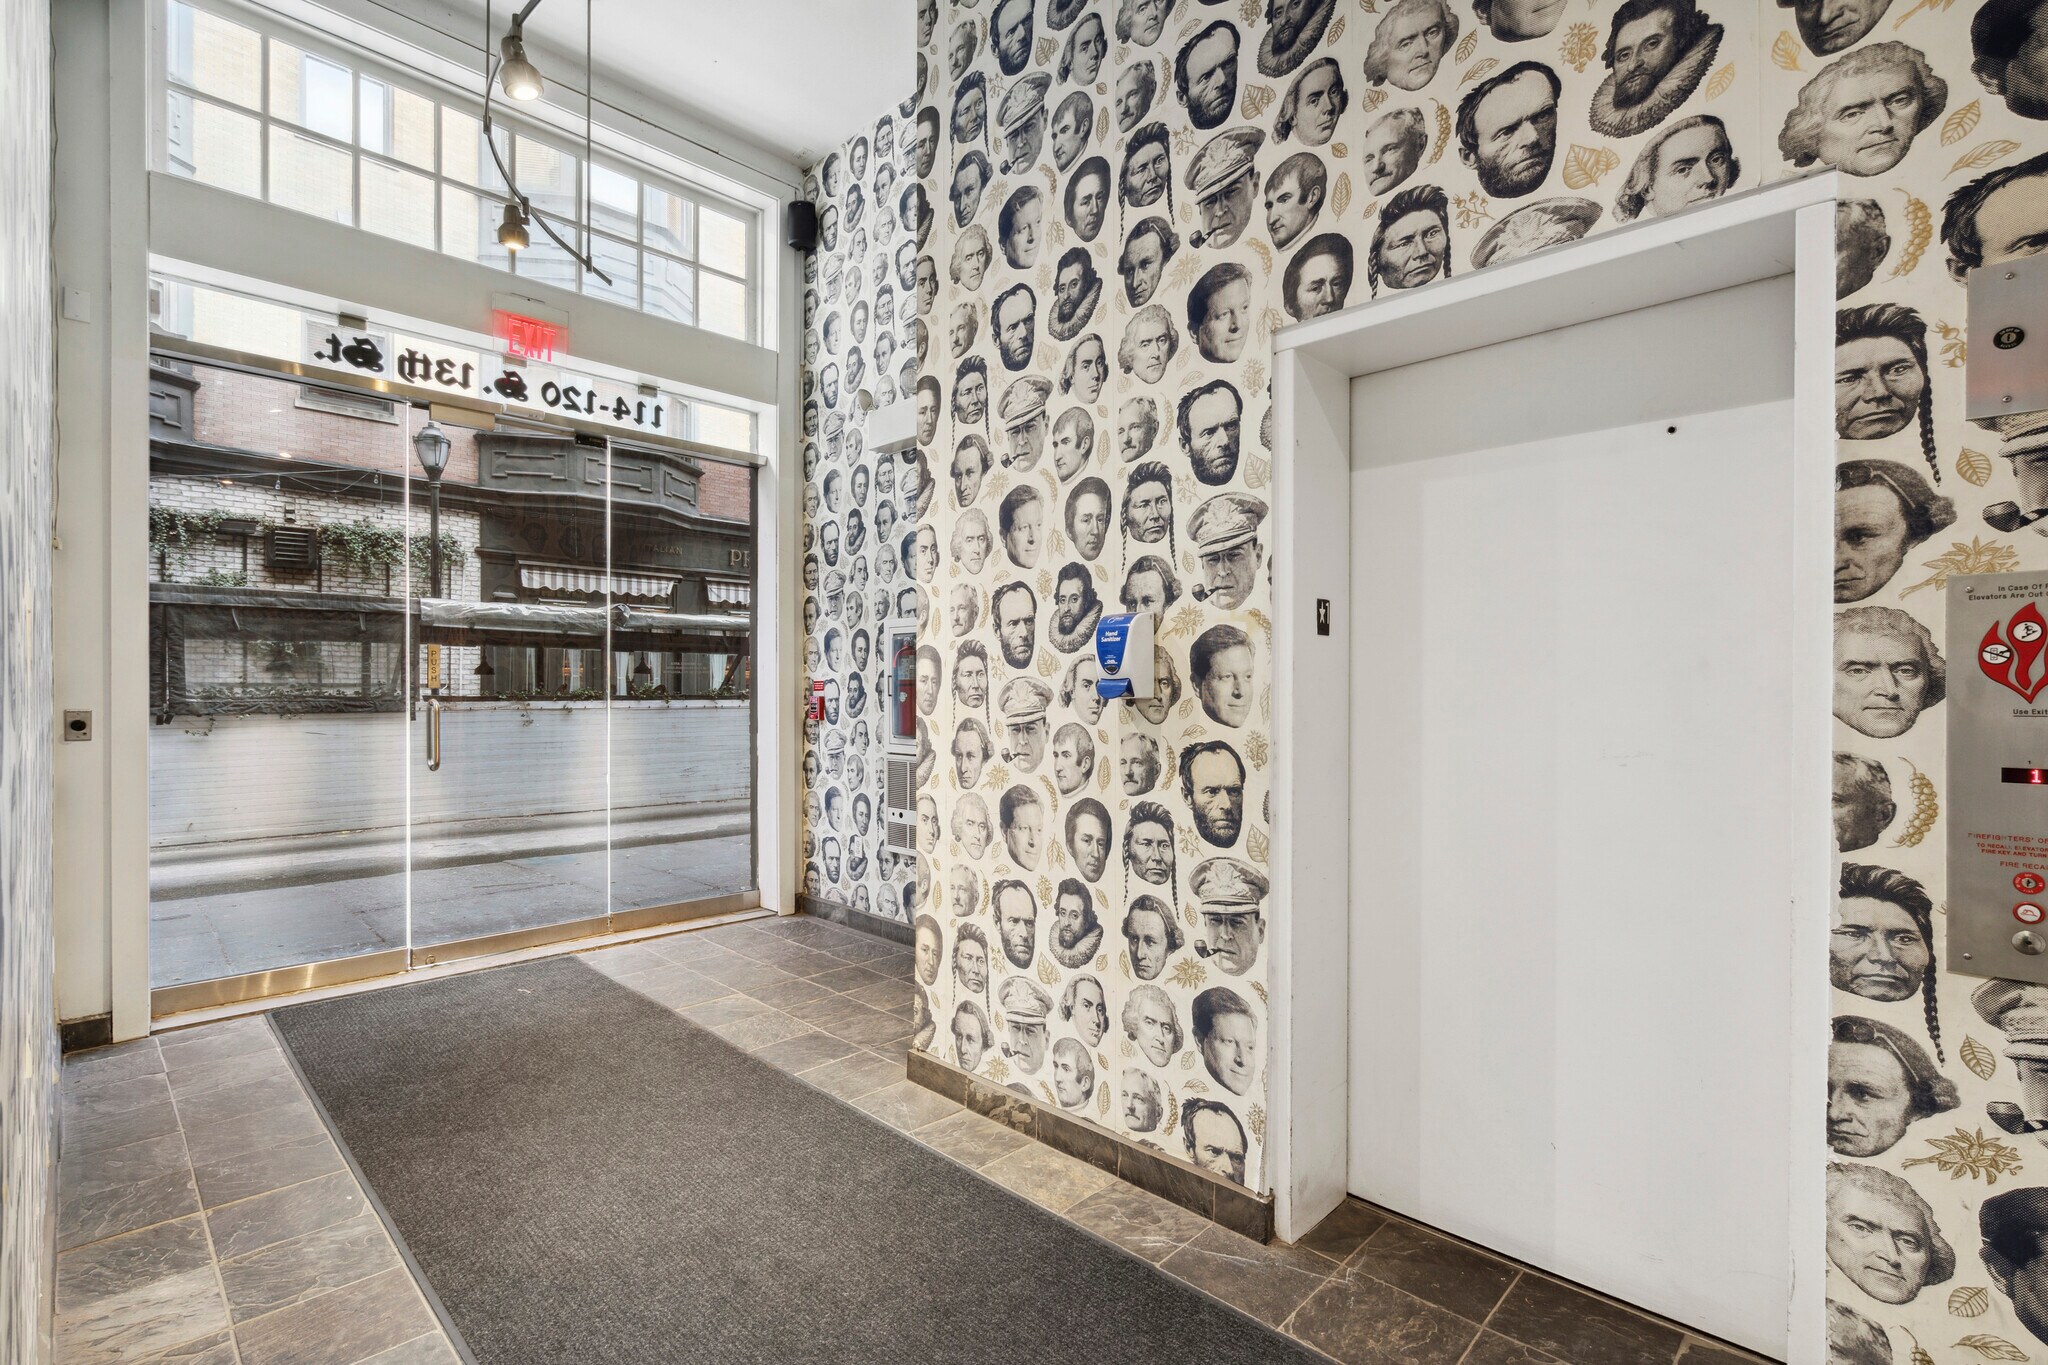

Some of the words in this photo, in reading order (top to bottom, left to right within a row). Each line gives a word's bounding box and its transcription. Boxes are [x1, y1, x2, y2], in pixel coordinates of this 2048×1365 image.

[508, 318, 556, 363] EXIT
[1968, 593, 2007, 601] Elevators
[2031, 769, 2041, 783] 1
[2000, 860, 2020, 869] FIRE
